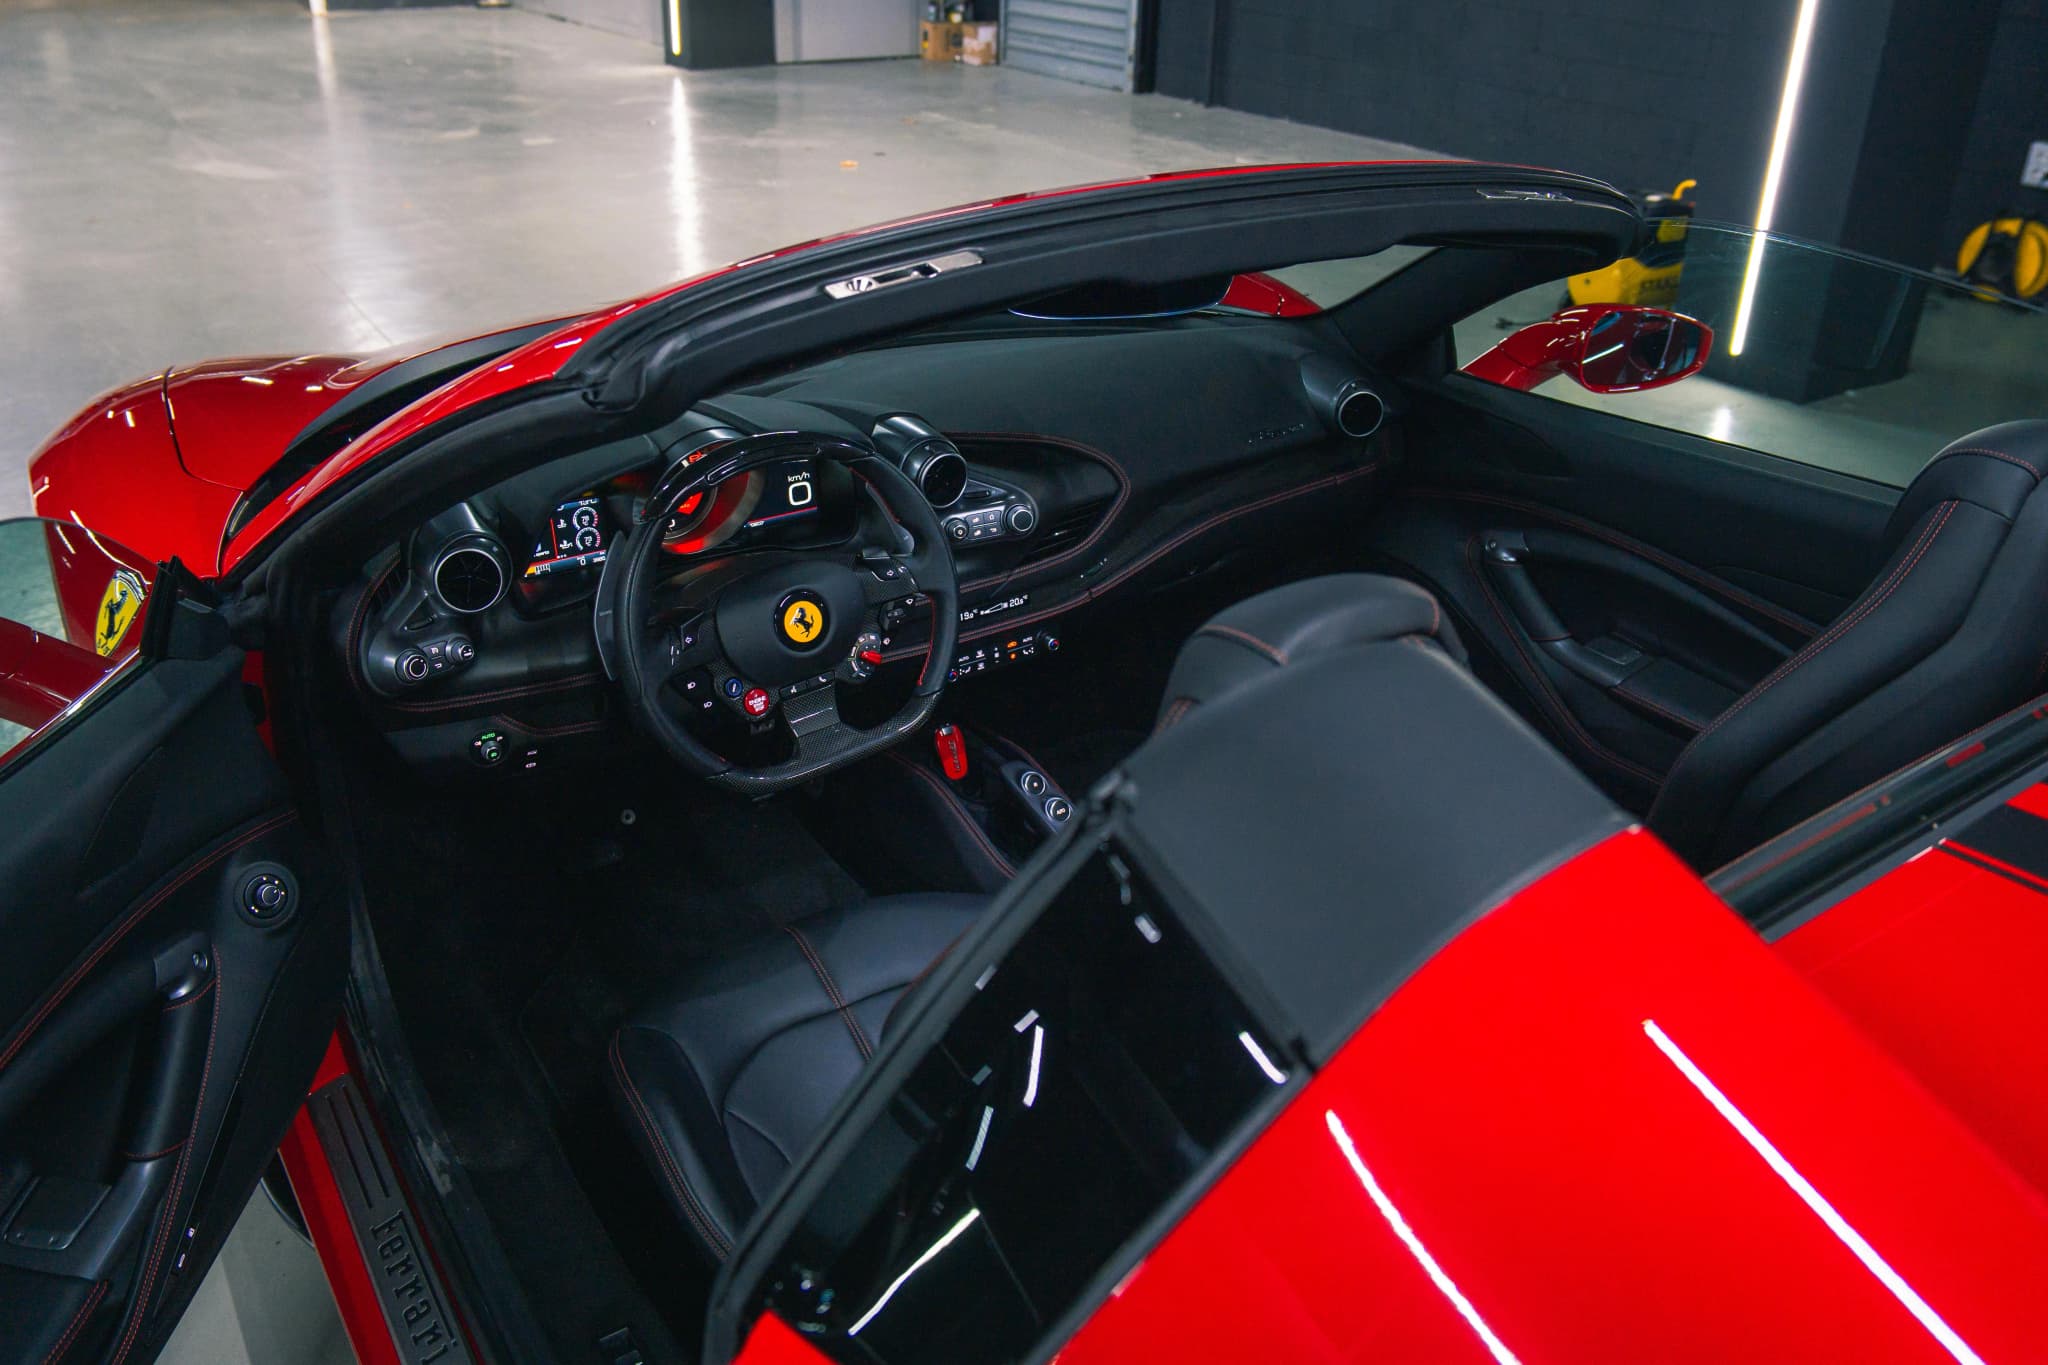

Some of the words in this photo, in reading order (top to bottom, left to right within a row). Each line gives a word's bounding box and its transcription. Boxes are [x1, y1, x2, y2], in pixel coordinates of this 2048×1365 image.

[788, 472, 810, 482] km/h
[789, 481, 811, 505] 0
[369, 1210, 459, 1365] Ferrari
